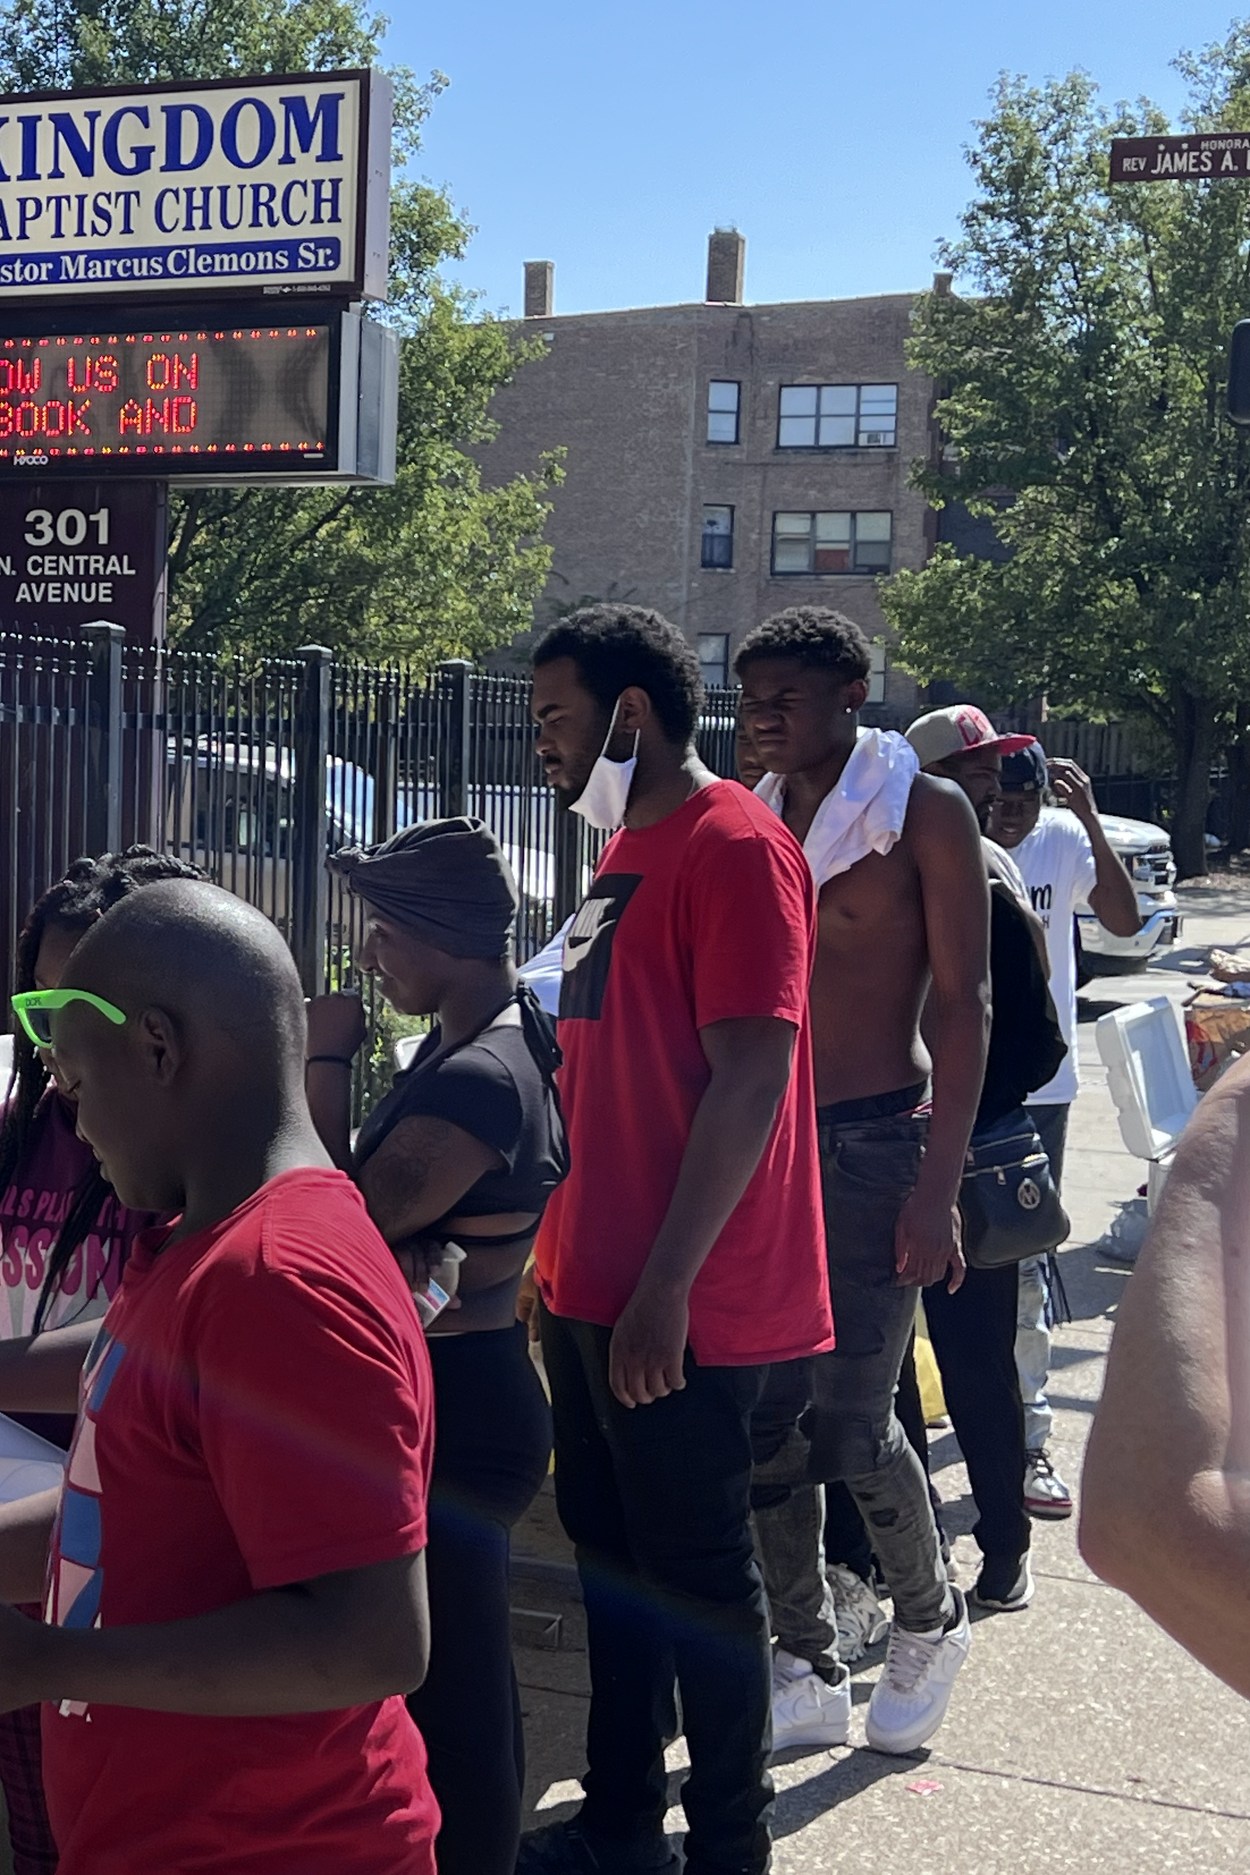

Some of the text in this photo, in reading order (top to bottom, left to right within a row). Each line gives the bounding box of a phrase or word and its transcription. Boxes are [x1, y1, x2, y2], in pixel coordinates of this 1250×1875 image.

[1122, 157, 1148, 172] REV
[1150, 151, 1213, 174] JAMES
[1220, 150, 1239, 171] A.
[154, 178, 343, 233] CHURCH
[58, 251, 163, 281] Marcus
[166, 247, 289, 276] Clemons
[297, 243, 336, 270] Sr.
[68, 354, 120, 393] US
[146, 353, 199, 391] ON
[119, 396, 198, 437] AND
[24, 508, 109, 547] 301
[26, 555, 136, 577] CENTRAL
[15, 582, 113, 603] AVENUE
